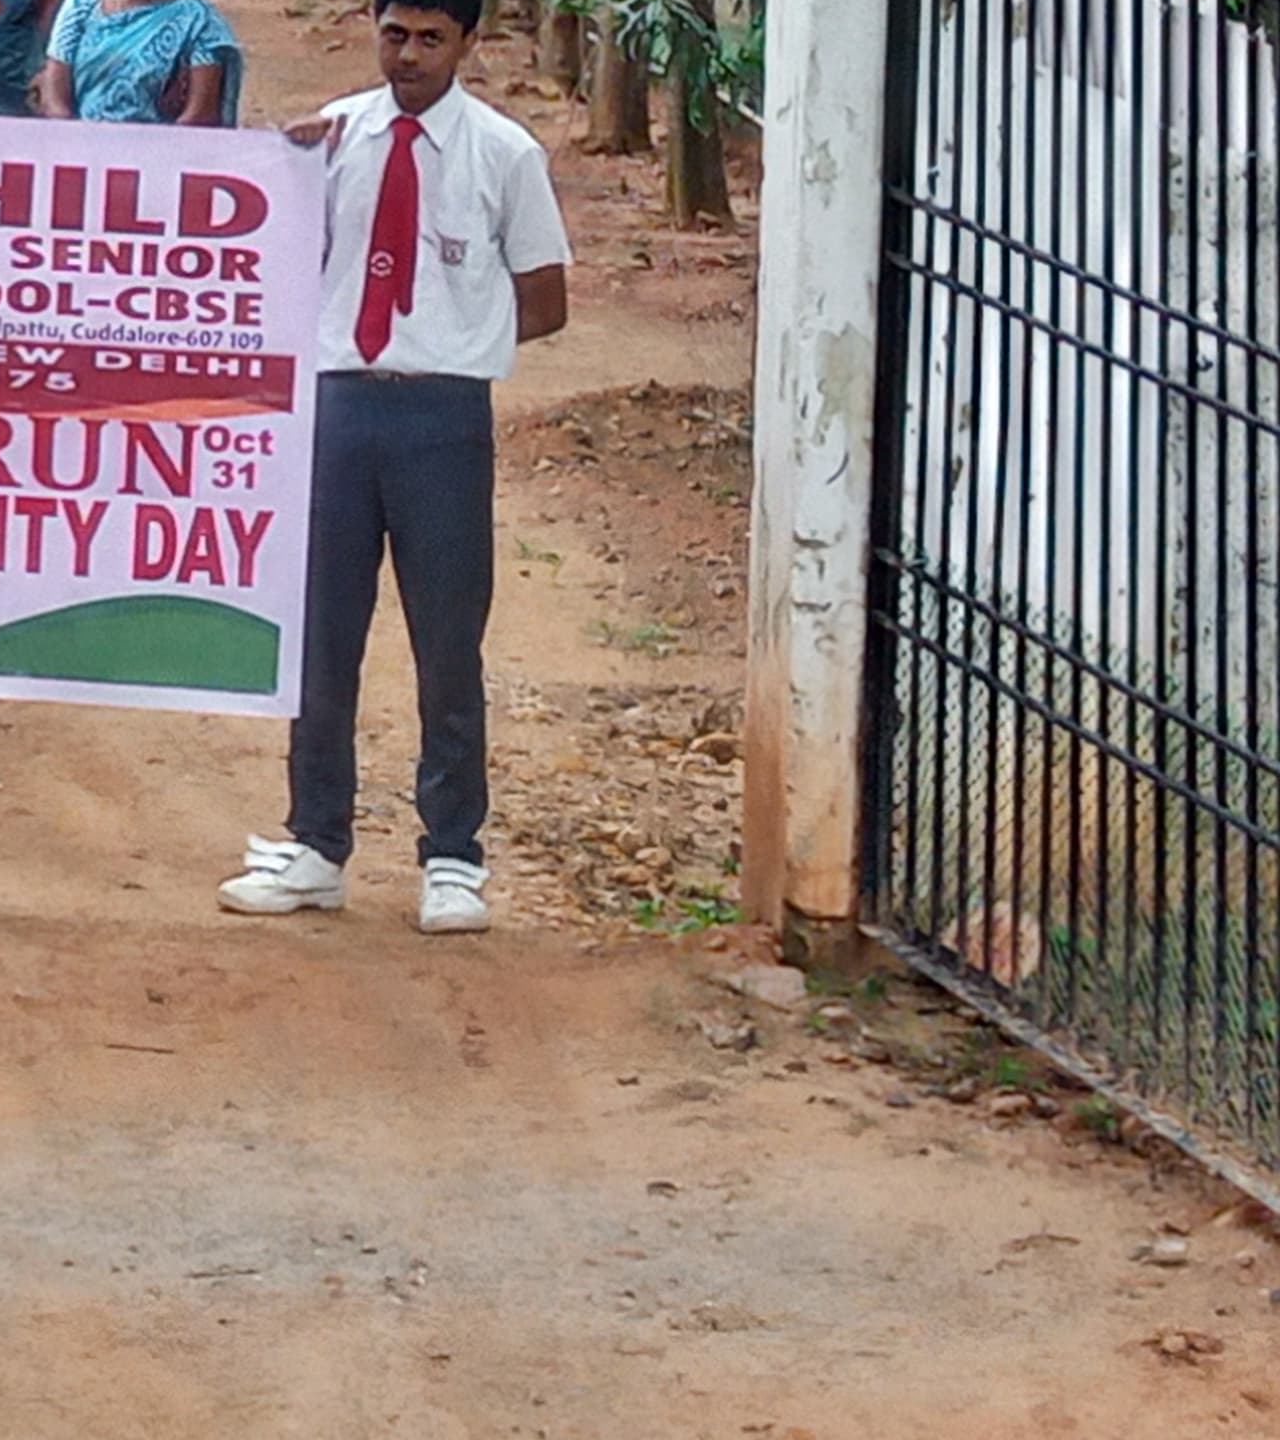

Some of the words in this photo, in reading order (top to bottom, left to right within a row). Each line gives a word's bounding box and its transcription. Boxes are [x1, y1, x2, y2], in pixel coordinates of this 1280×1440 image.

[10, 237, 262, 283] SENIOR
[72, 323, 224, 349] Cuddalore-607
[229, 333, 264, 351] 109
[95, 352, 263, 376] DELHI
[204, 425, 273, 457] Oct
[212, 460, 256, 490] 31
[132, 503, 274, 587] DAY
